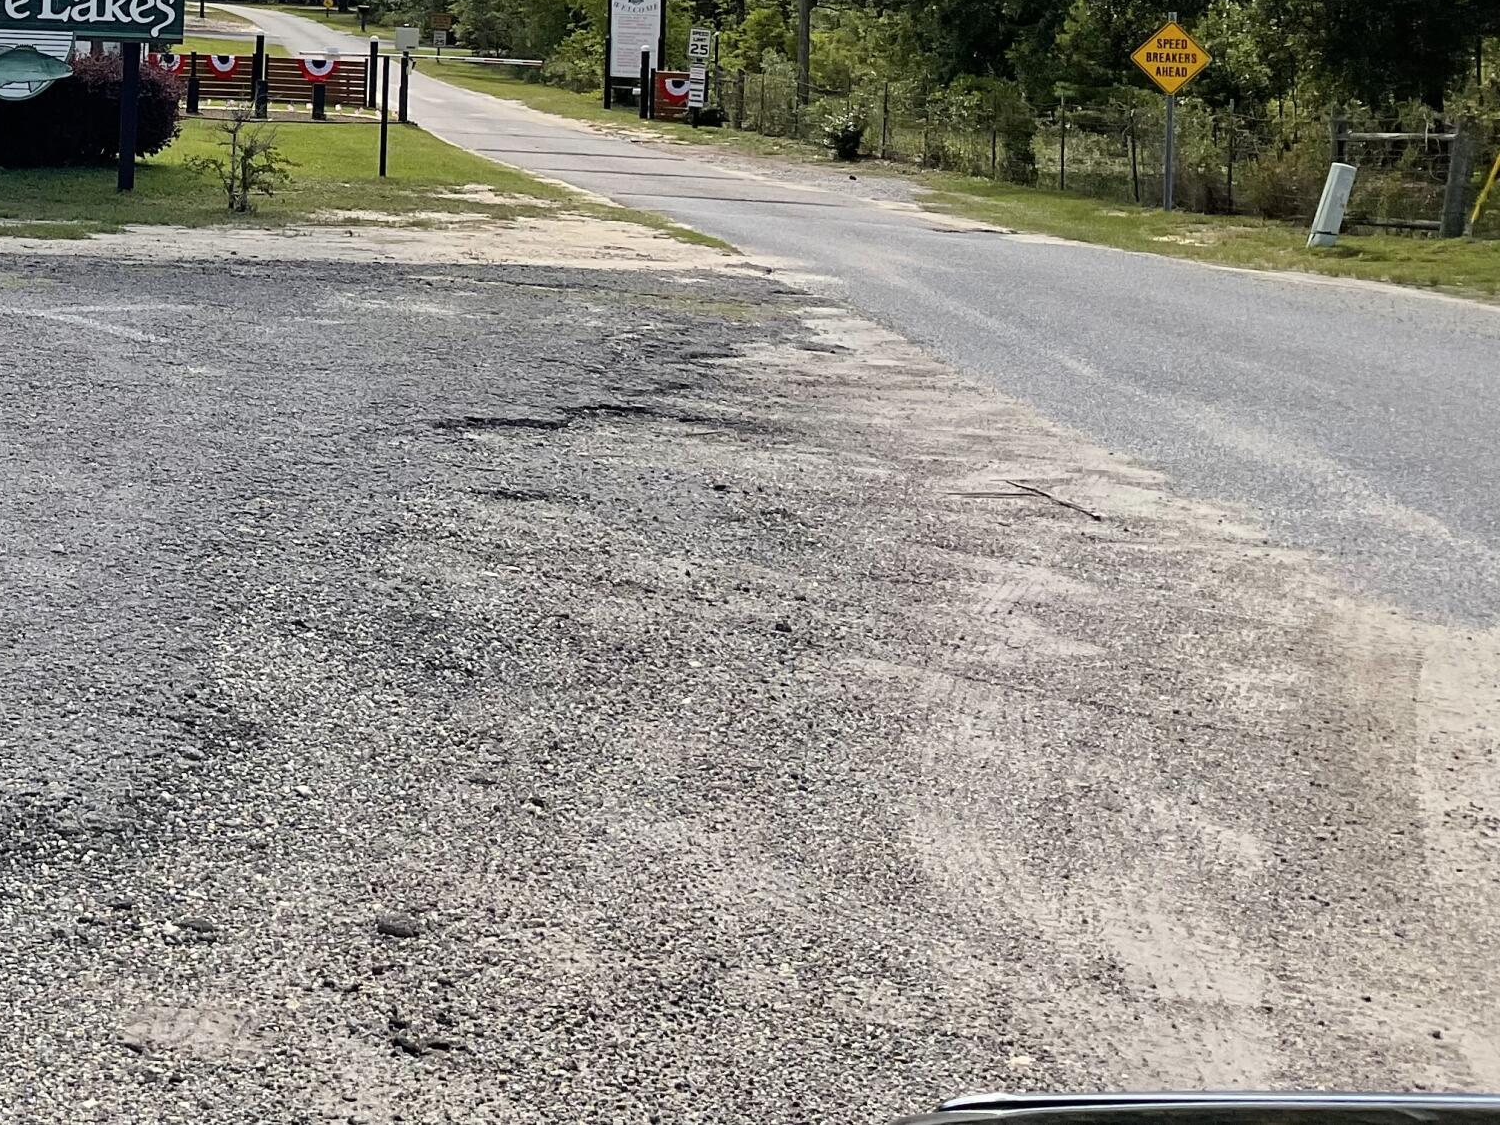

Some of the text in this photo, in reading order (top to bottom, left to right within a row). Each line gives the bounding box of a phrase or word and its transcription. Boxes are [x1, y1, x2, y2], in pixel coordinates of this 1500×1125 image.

[690, 43, 708, 55] 25
[1156, 39, 1188, 49] SPEED
[1146, 52, 1197, 64] BREAKERS
[1156, 66, 1188, 77] AHEAD
